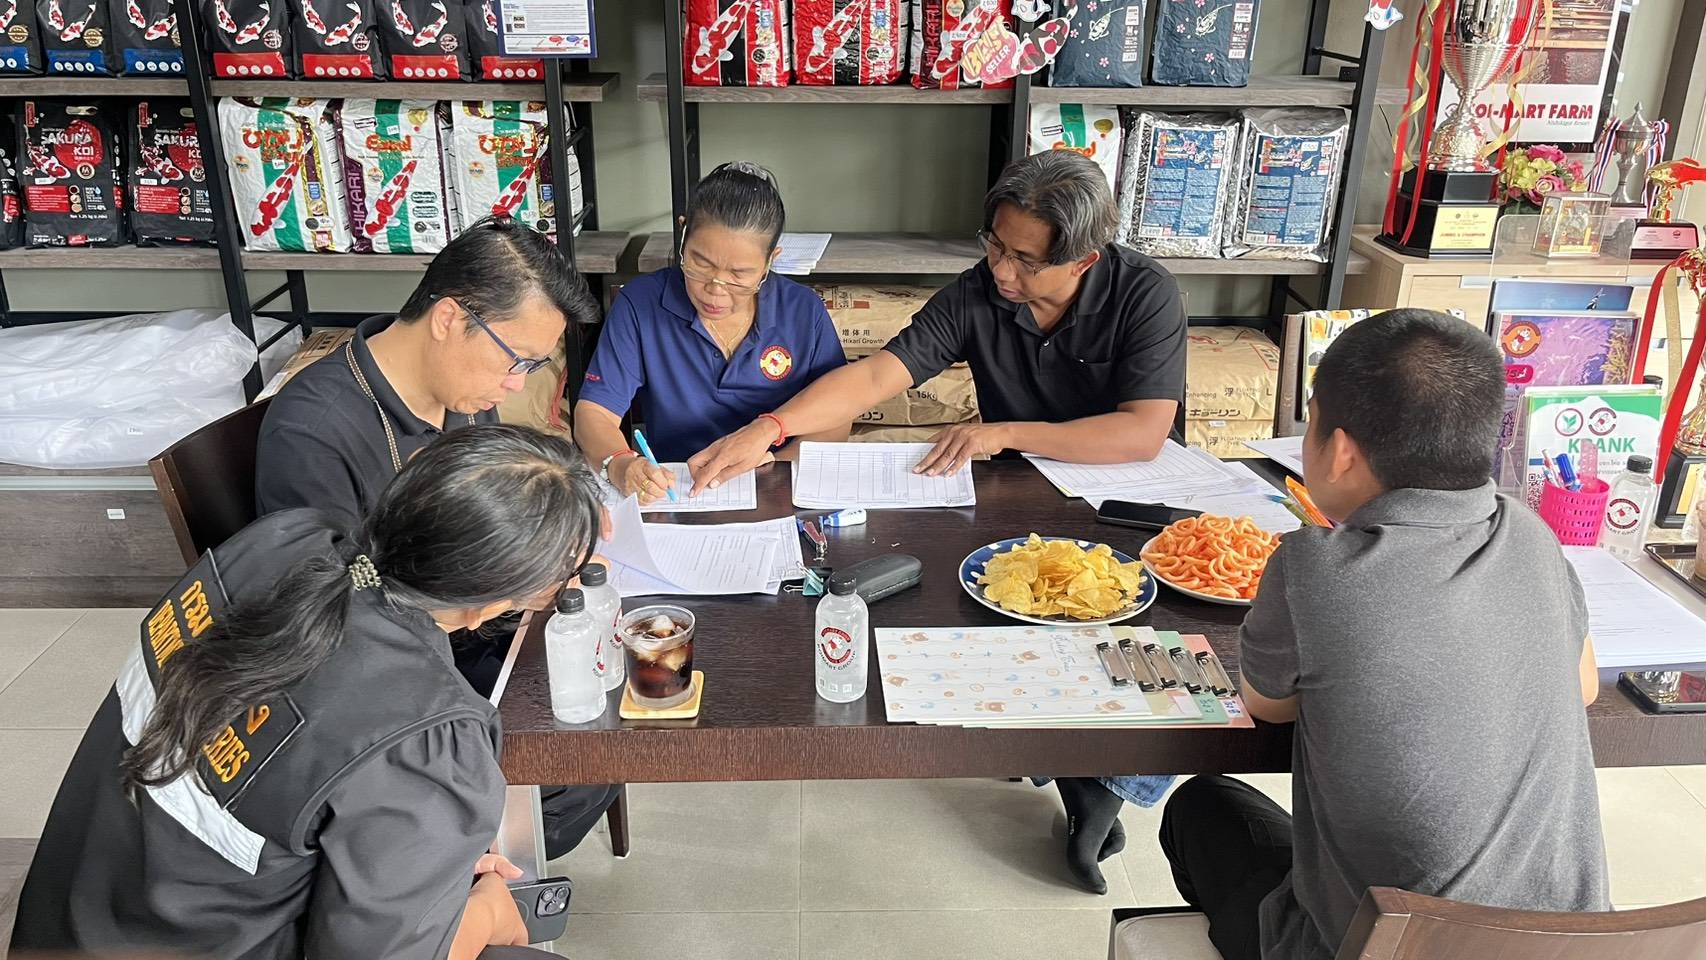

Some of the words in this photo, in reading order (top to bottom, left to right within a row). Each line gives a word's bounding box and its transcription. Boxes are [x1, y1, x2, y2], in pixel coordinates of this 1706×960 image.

[985, 45, 1011, 75] SELLER
[1548, 104, 1593, 119] FARM
[41, 132, 92, 146] SAKURA
[154, 133, 200, 149] SAKUR
[73, 145, 95, 156] KOI
[348, 165, 364, 231] HIKARI
[1567, 437, 1636, 454] KANK
